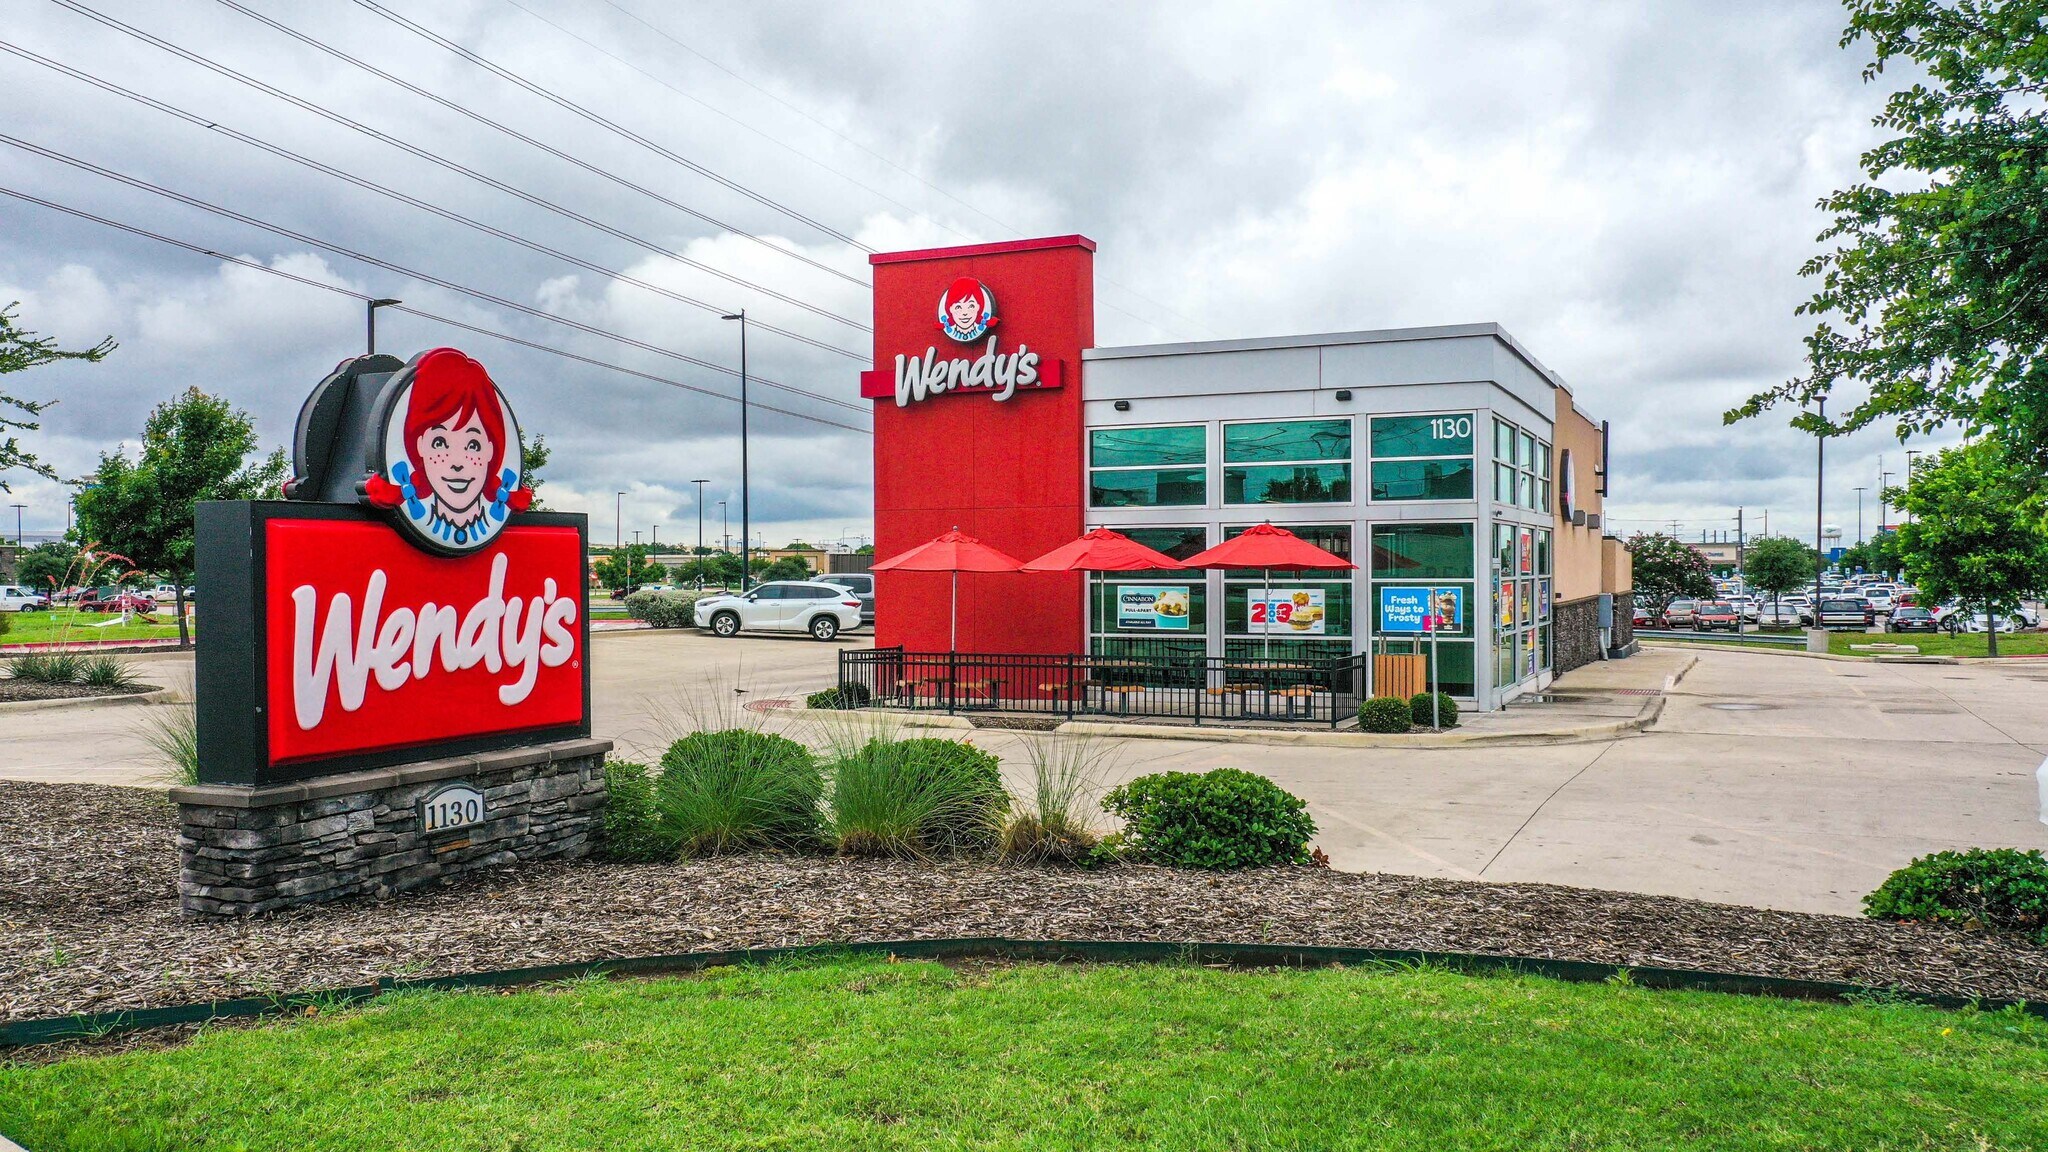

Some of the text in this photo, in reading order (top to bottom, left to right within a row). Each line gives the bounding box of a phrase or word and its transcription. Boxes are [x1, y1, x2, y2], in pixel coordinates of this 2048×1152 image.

[895, 336, 1038, 407] Wendy's
[1431, 417, 1471, 439] 1130
[1385, 605, 1412, 615] Ways
[1391, 596, 1418, 604] Fresh
[1251, 603, 1266, 623] 2
[1388, 614, 1420, 624] Frosty
[292, 552, 576, 730] Wendy's
[428, 799, 478, 830] 1130
